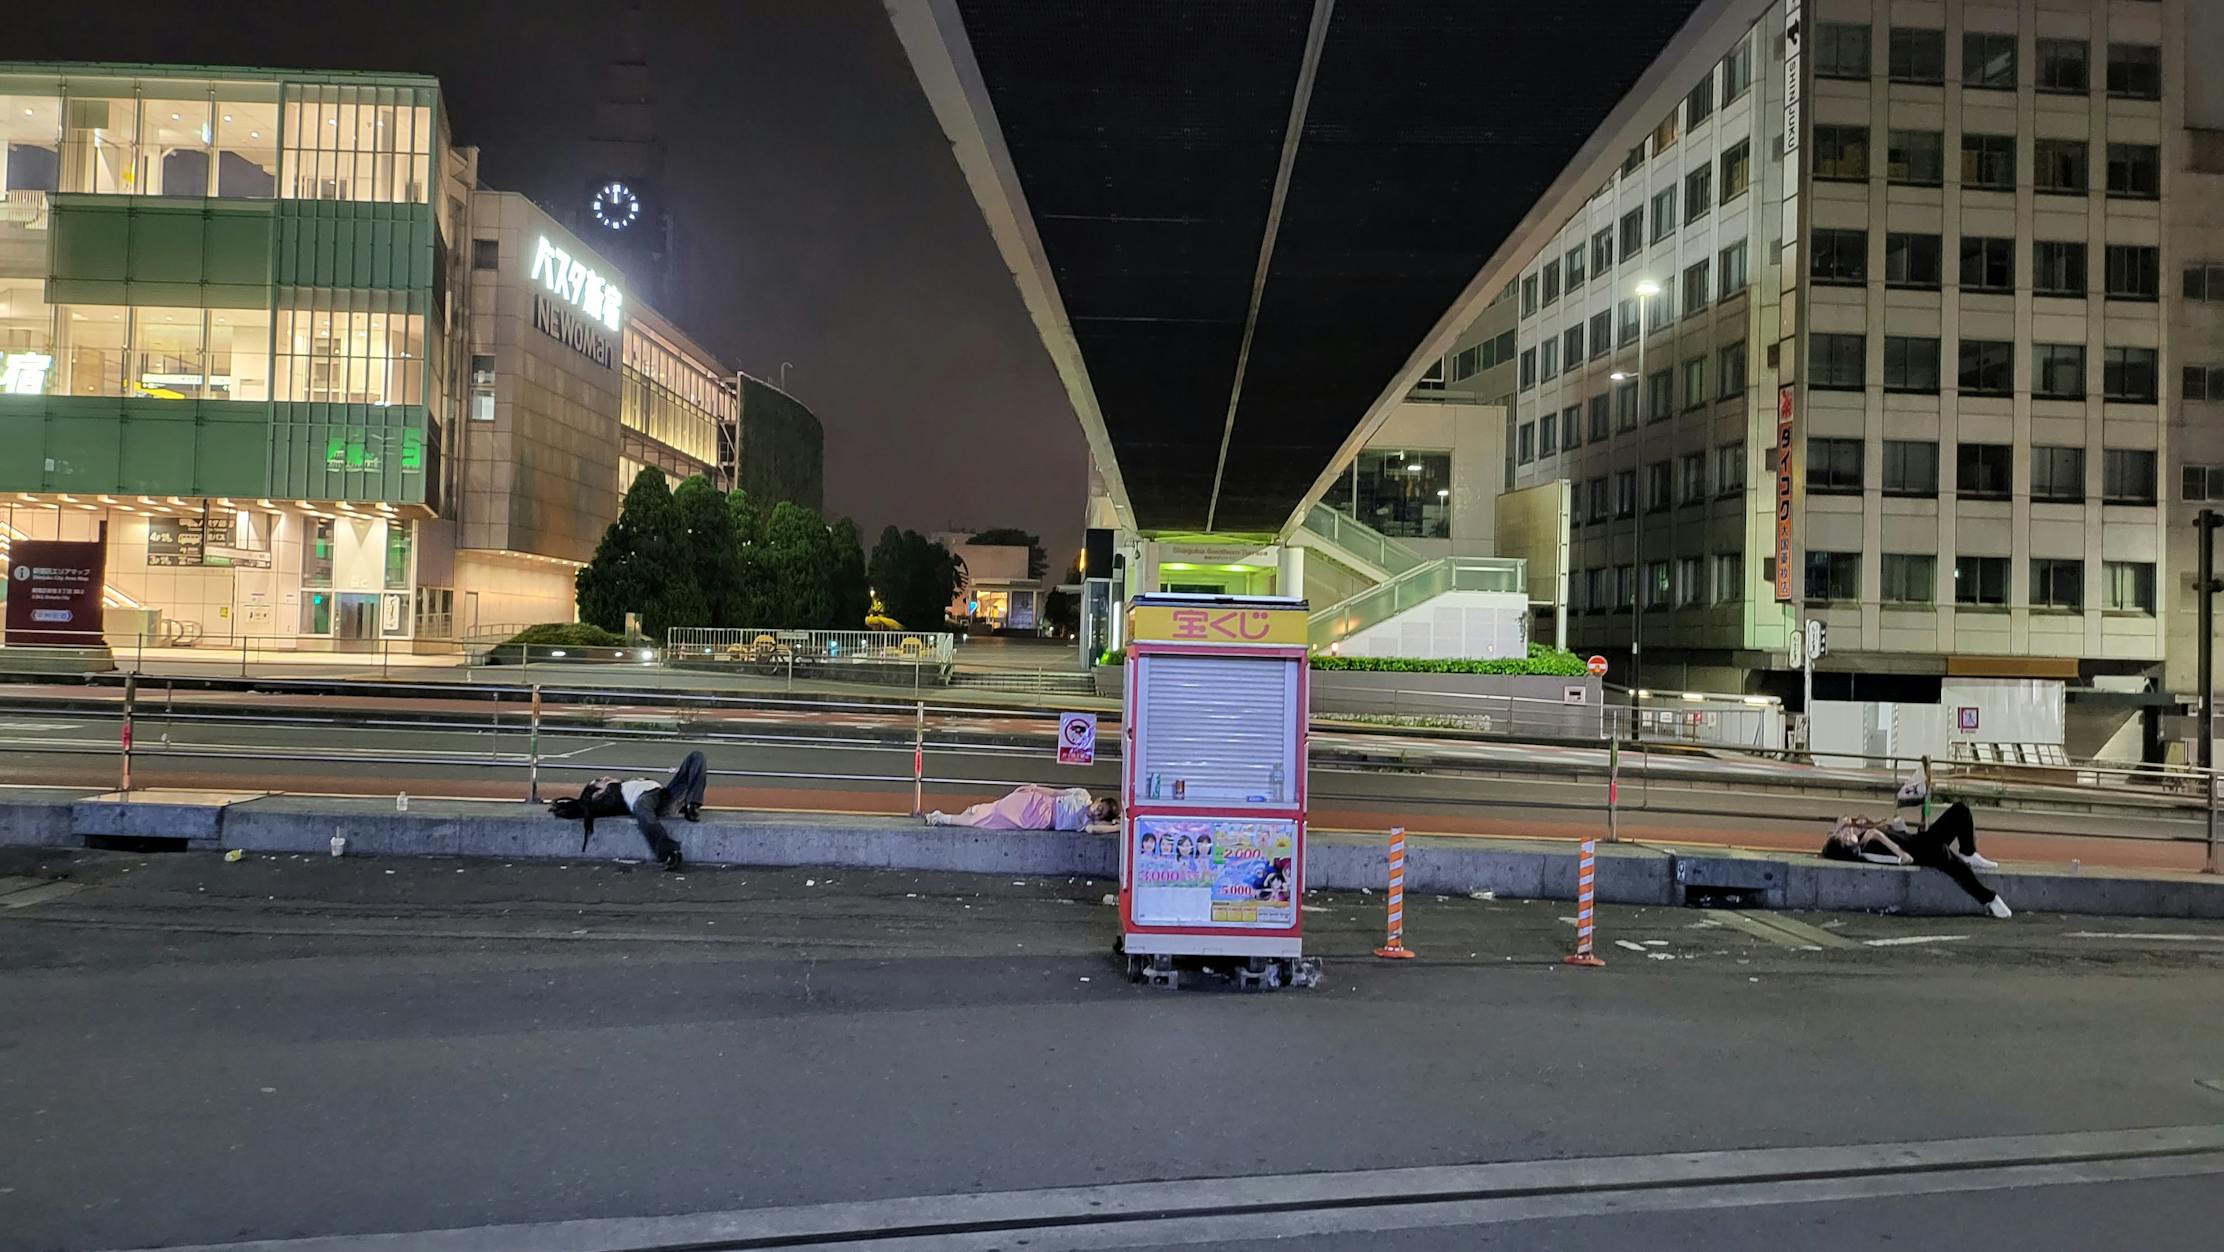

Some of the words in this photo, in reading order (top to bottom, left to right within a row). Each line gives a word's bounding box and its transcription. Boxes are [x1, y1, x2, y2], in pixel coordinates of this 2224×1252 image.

[531, 235, 623, 332] バスタ新宿
[1172, 610, 1270, 640] 宝くじ
